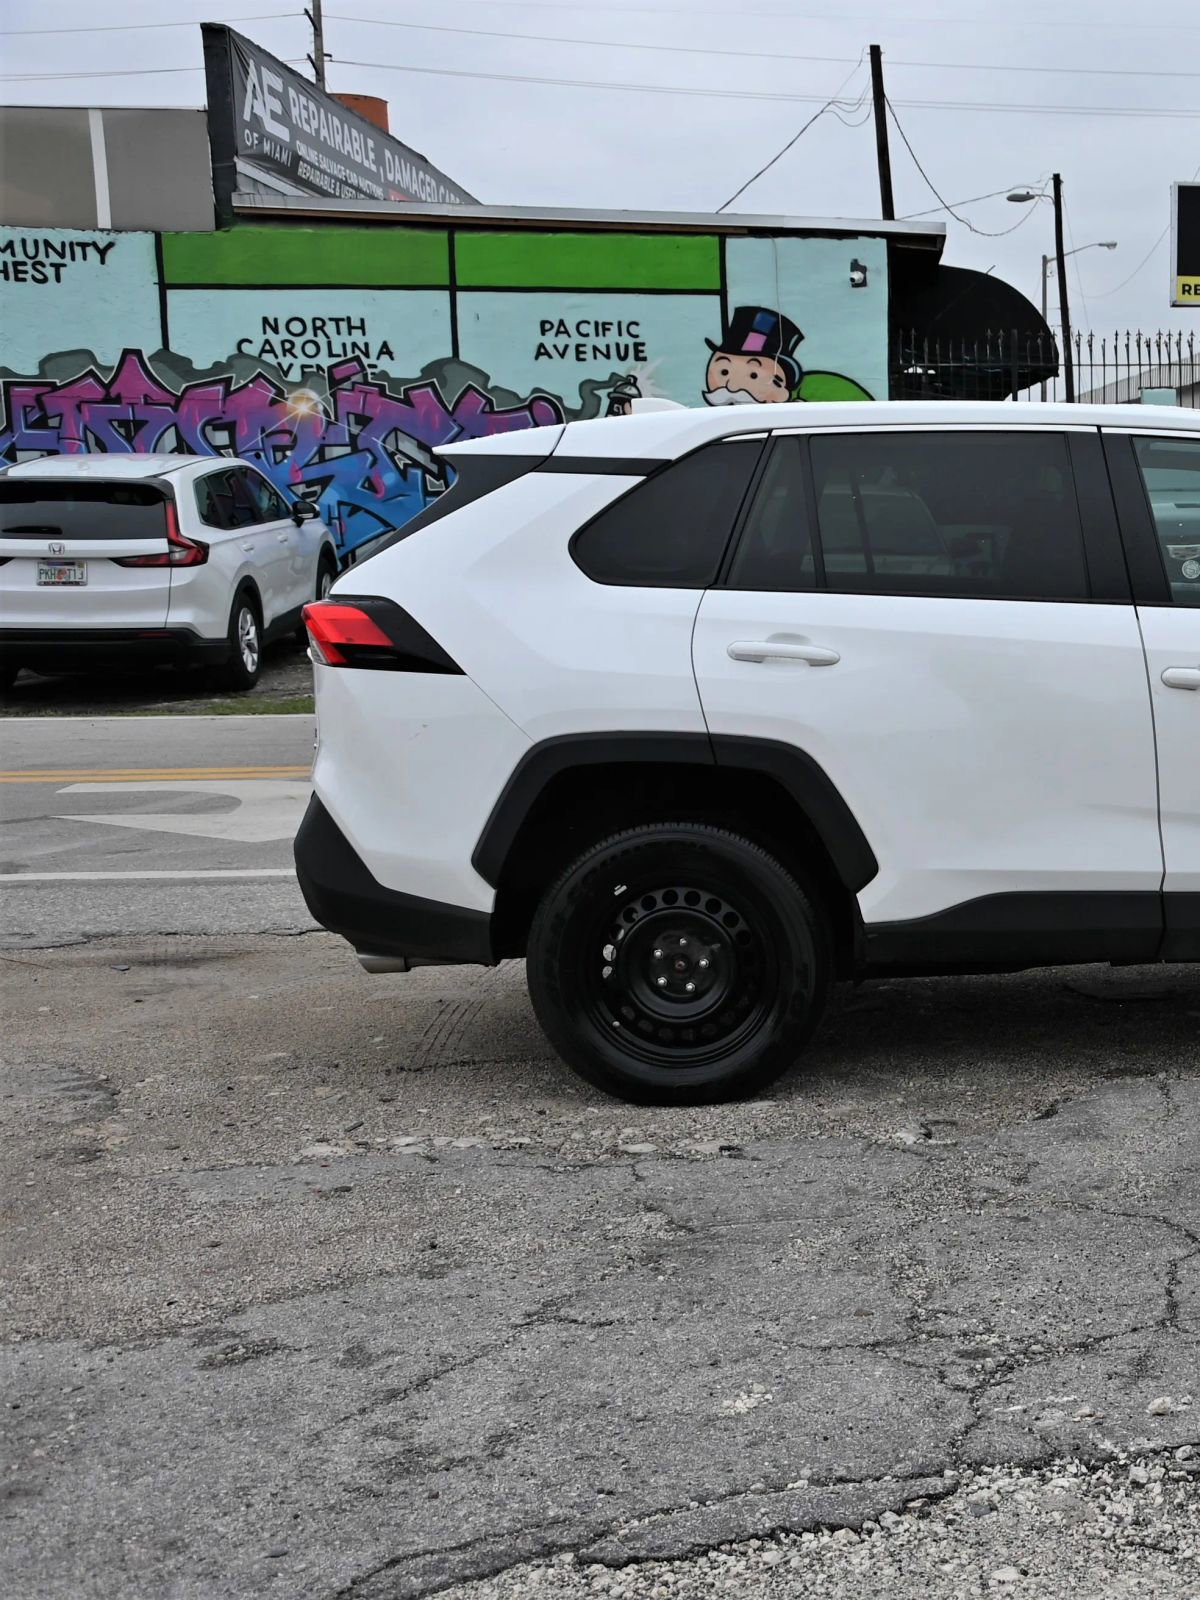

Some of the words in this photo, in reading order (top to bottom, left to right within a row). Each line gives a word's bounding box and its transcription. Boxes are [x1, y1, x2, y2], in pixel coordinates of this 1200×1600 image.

[243, 58, 290, 143] AE
[244, 129, 259, 150] OF
[263, 137, 292, 168] MIAMI
[297, 161, 335, 194] REPAIRABLE
[385, 148, 437, 203] DAMAGED
[262, 316, 367, 340] NORTH
[539, 318, 641, 339] PACIFIC
[236, 338, 395, 361] CAROLINA
[534, 342, 648, 362] AVENUE
